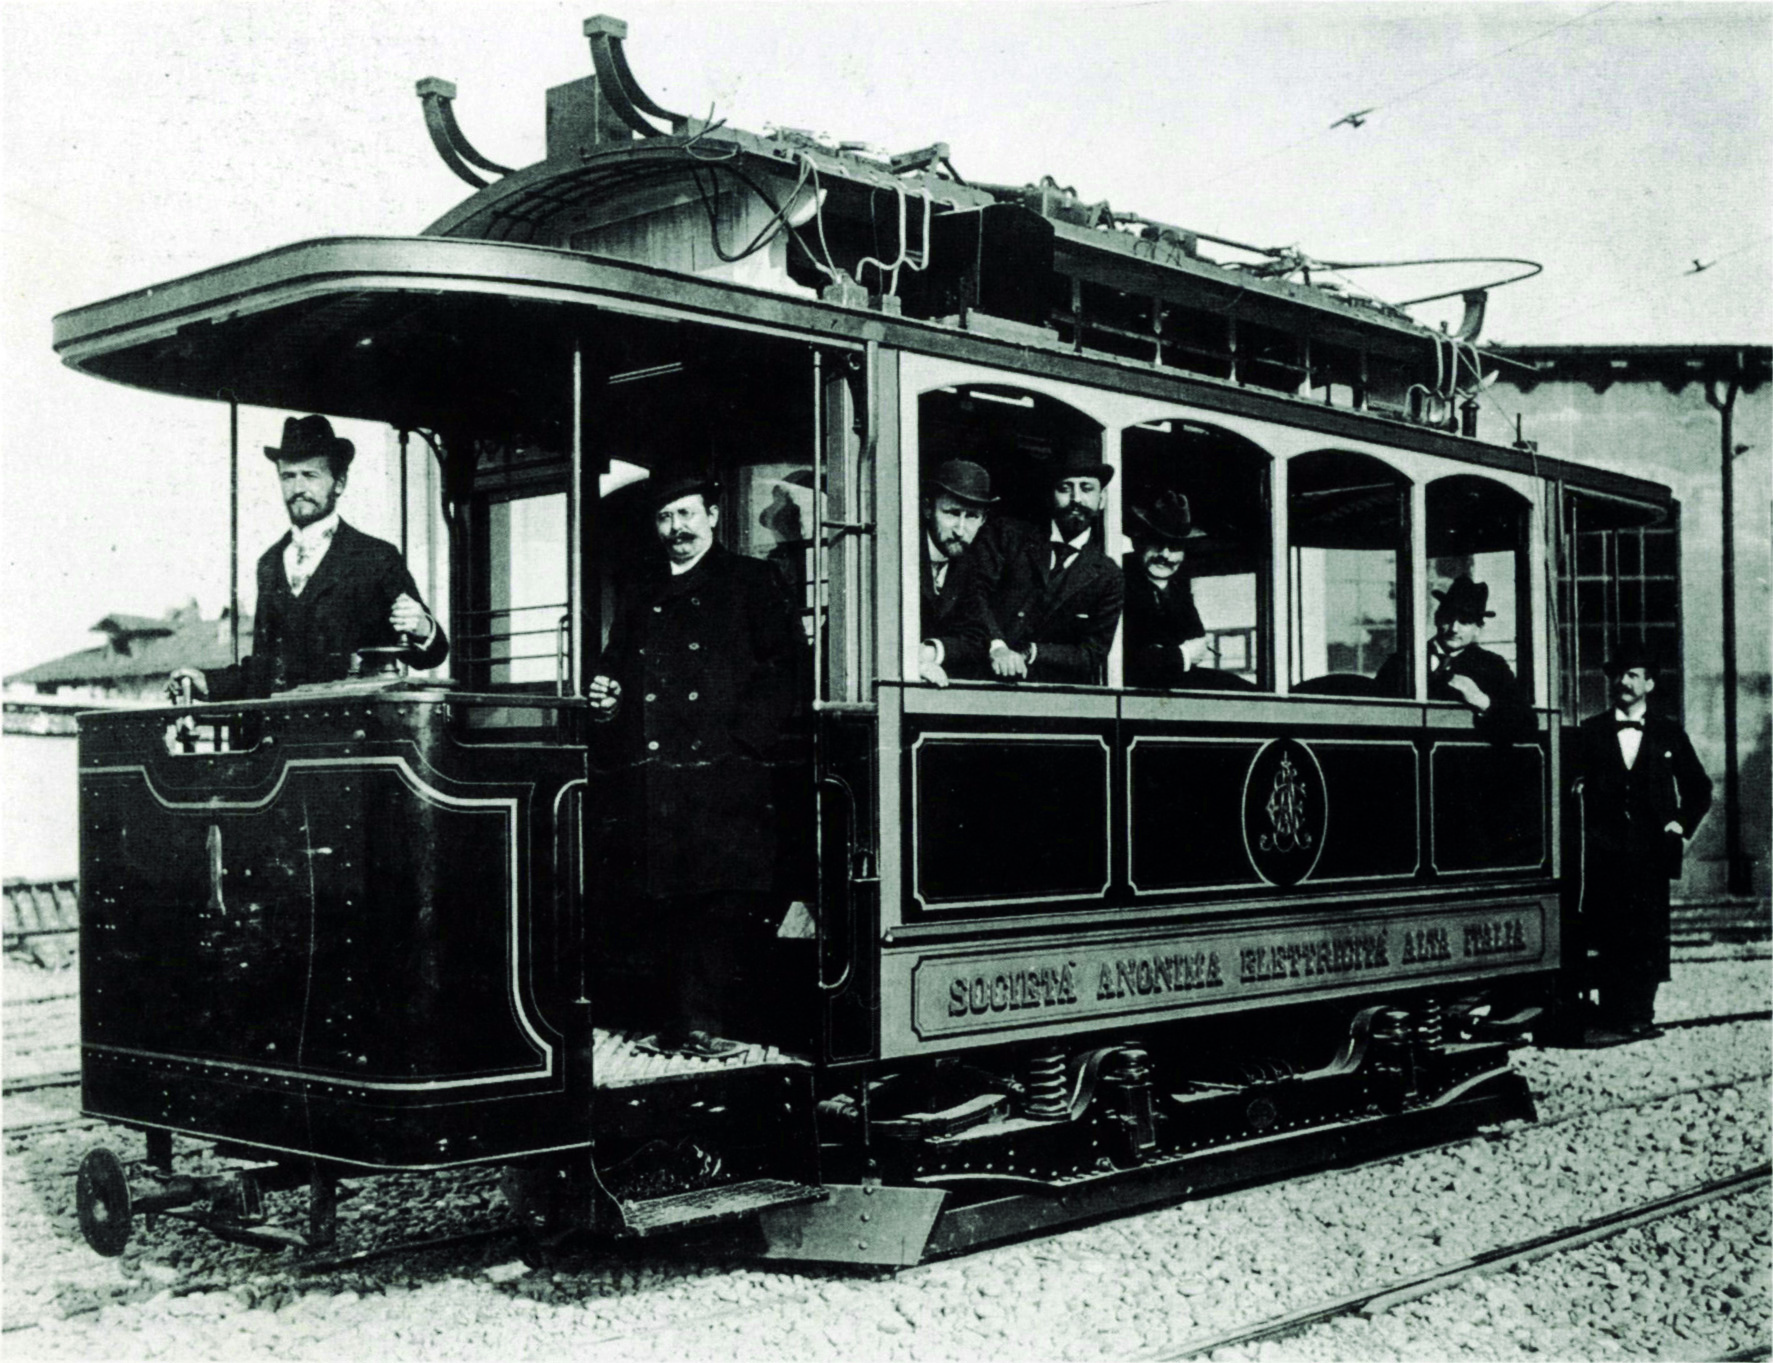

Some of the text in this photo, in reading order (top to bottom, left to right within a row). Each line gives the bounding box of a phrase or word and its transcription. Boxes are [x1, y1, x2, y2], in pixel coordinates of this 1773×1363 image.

[1096, 950, 1224, 1000] ANONIMA
[1401, 927, 1452, 965] ALTA
[1463, 918, 1527, 957] ITALIA
